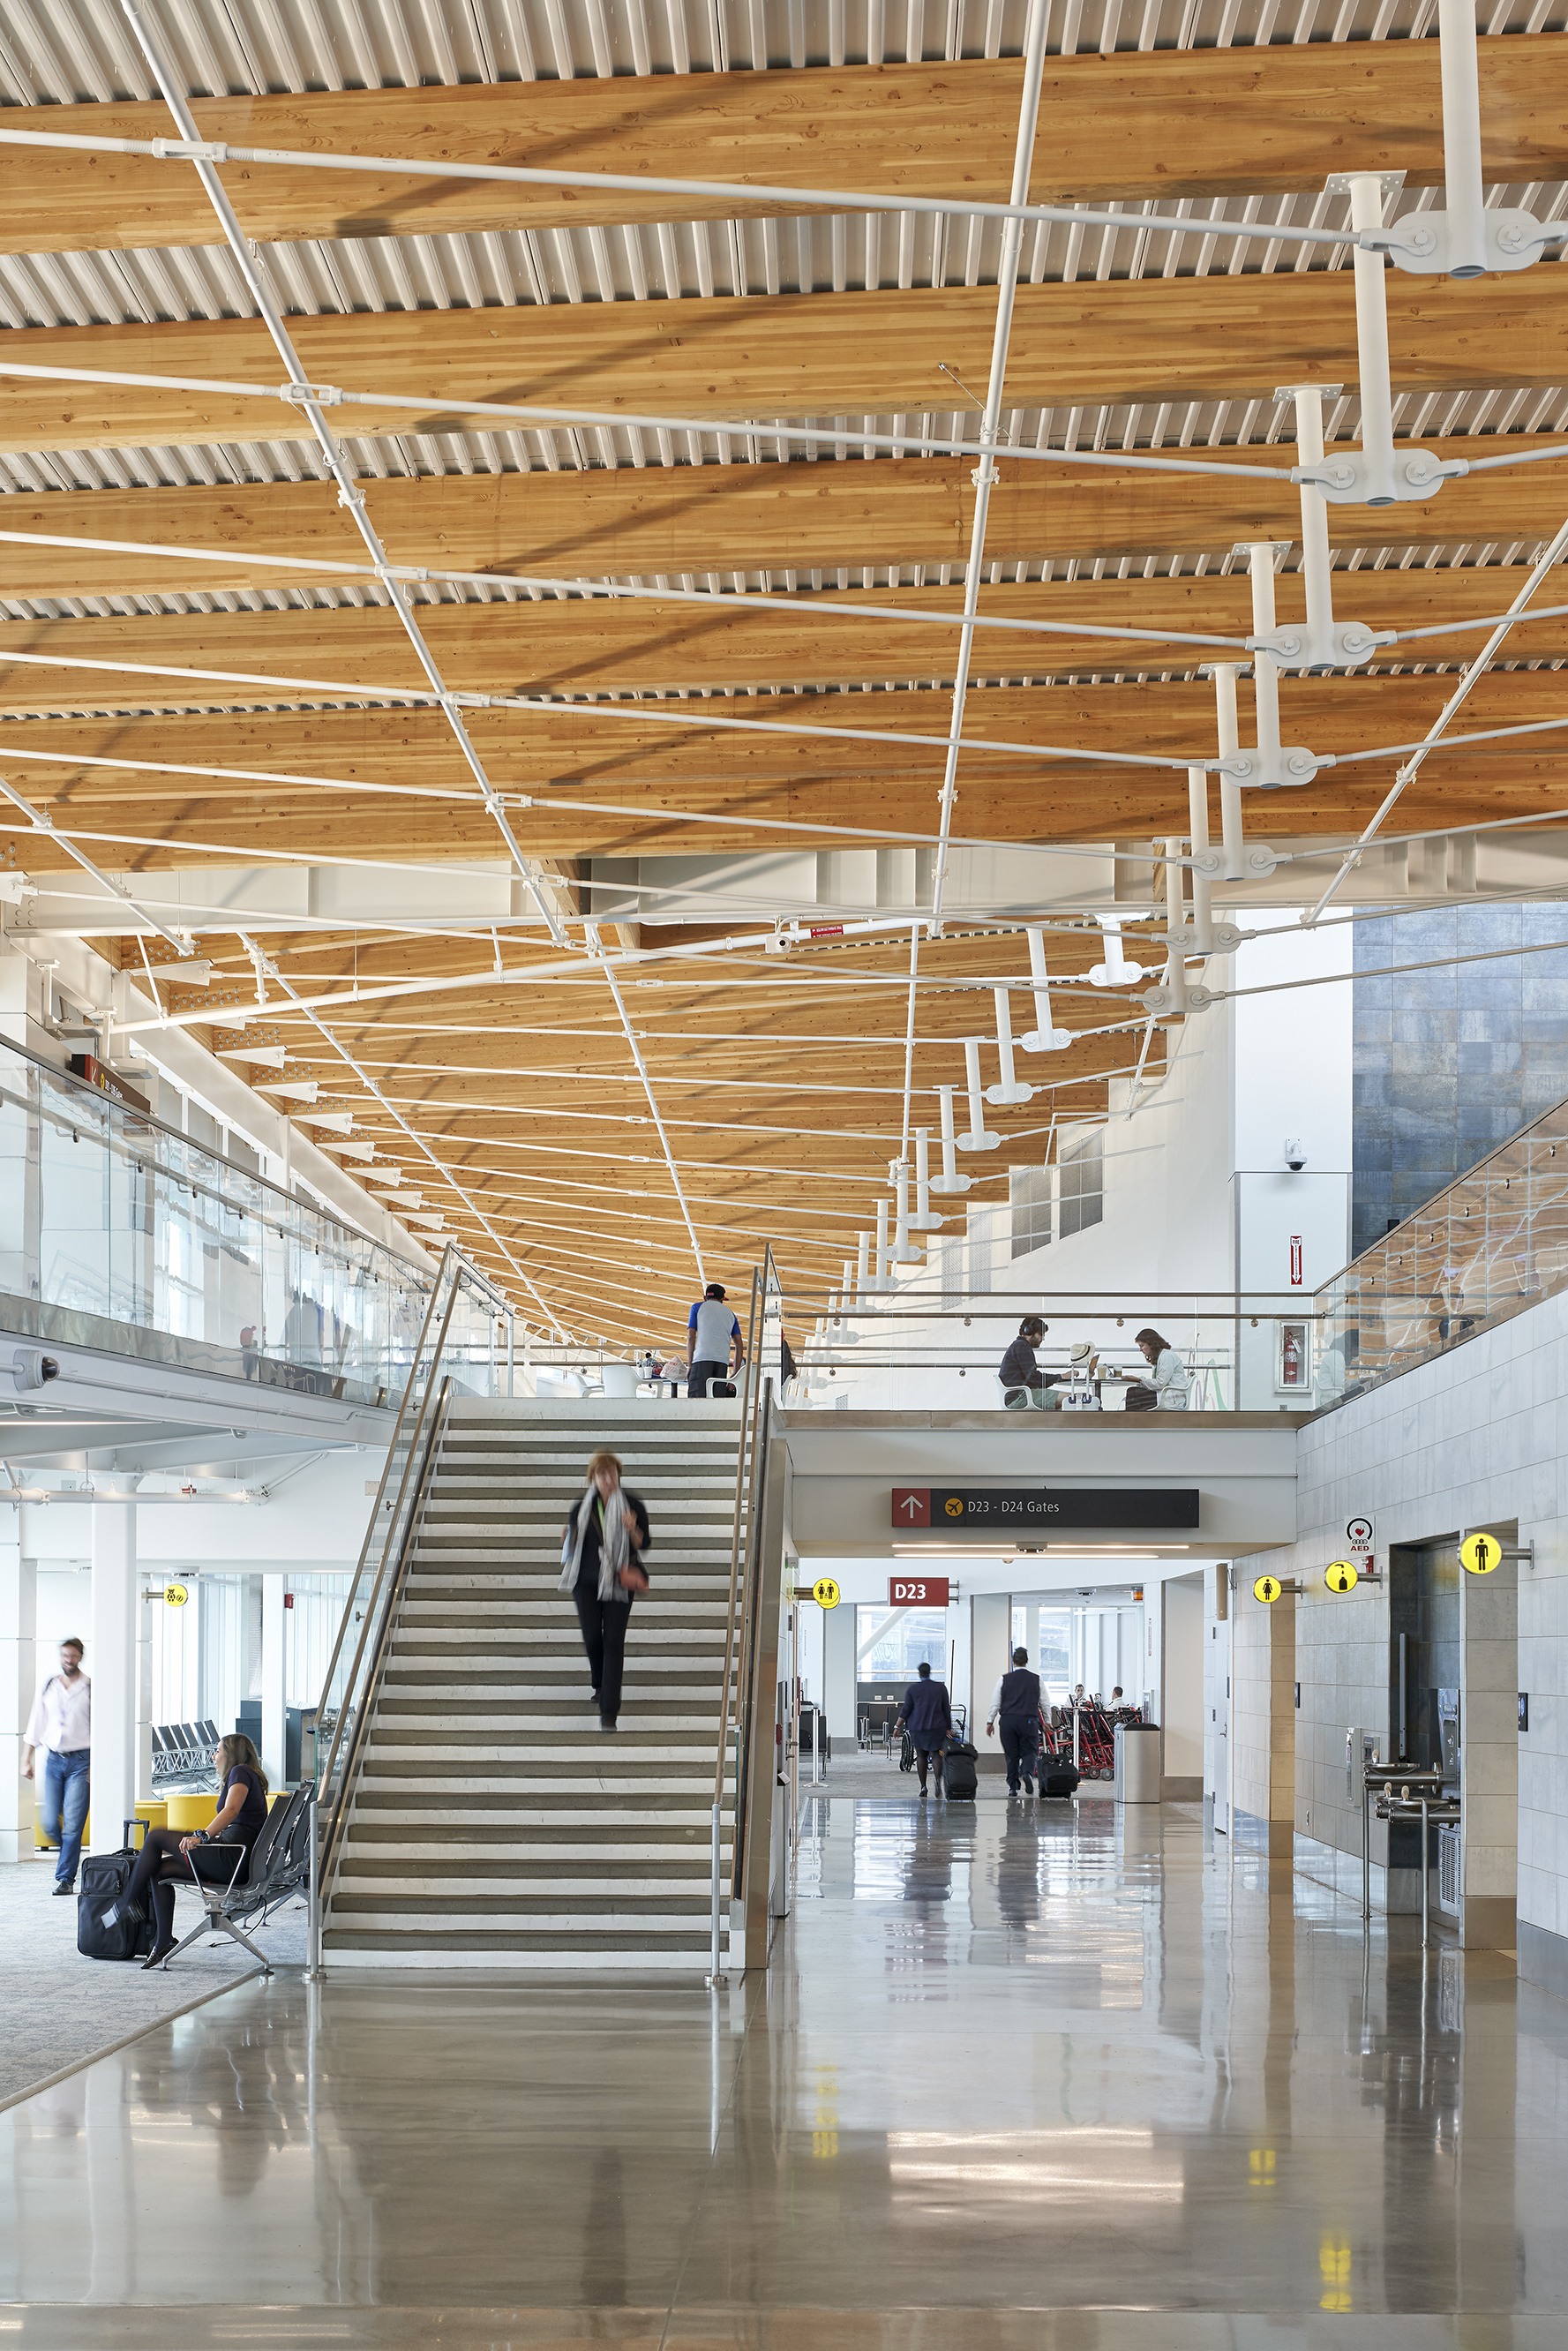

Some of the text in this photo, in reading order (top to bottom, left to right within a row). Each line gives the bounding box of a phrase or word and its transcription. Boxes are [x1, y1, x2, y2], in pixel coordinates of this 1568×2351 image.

[968, 1501, 989, 1513] D23
[1002, 1501, 1023, 1513] D24
[1027, 1501, 1060, 1513] Gates
[895, 1583, 927, 1600] D23
